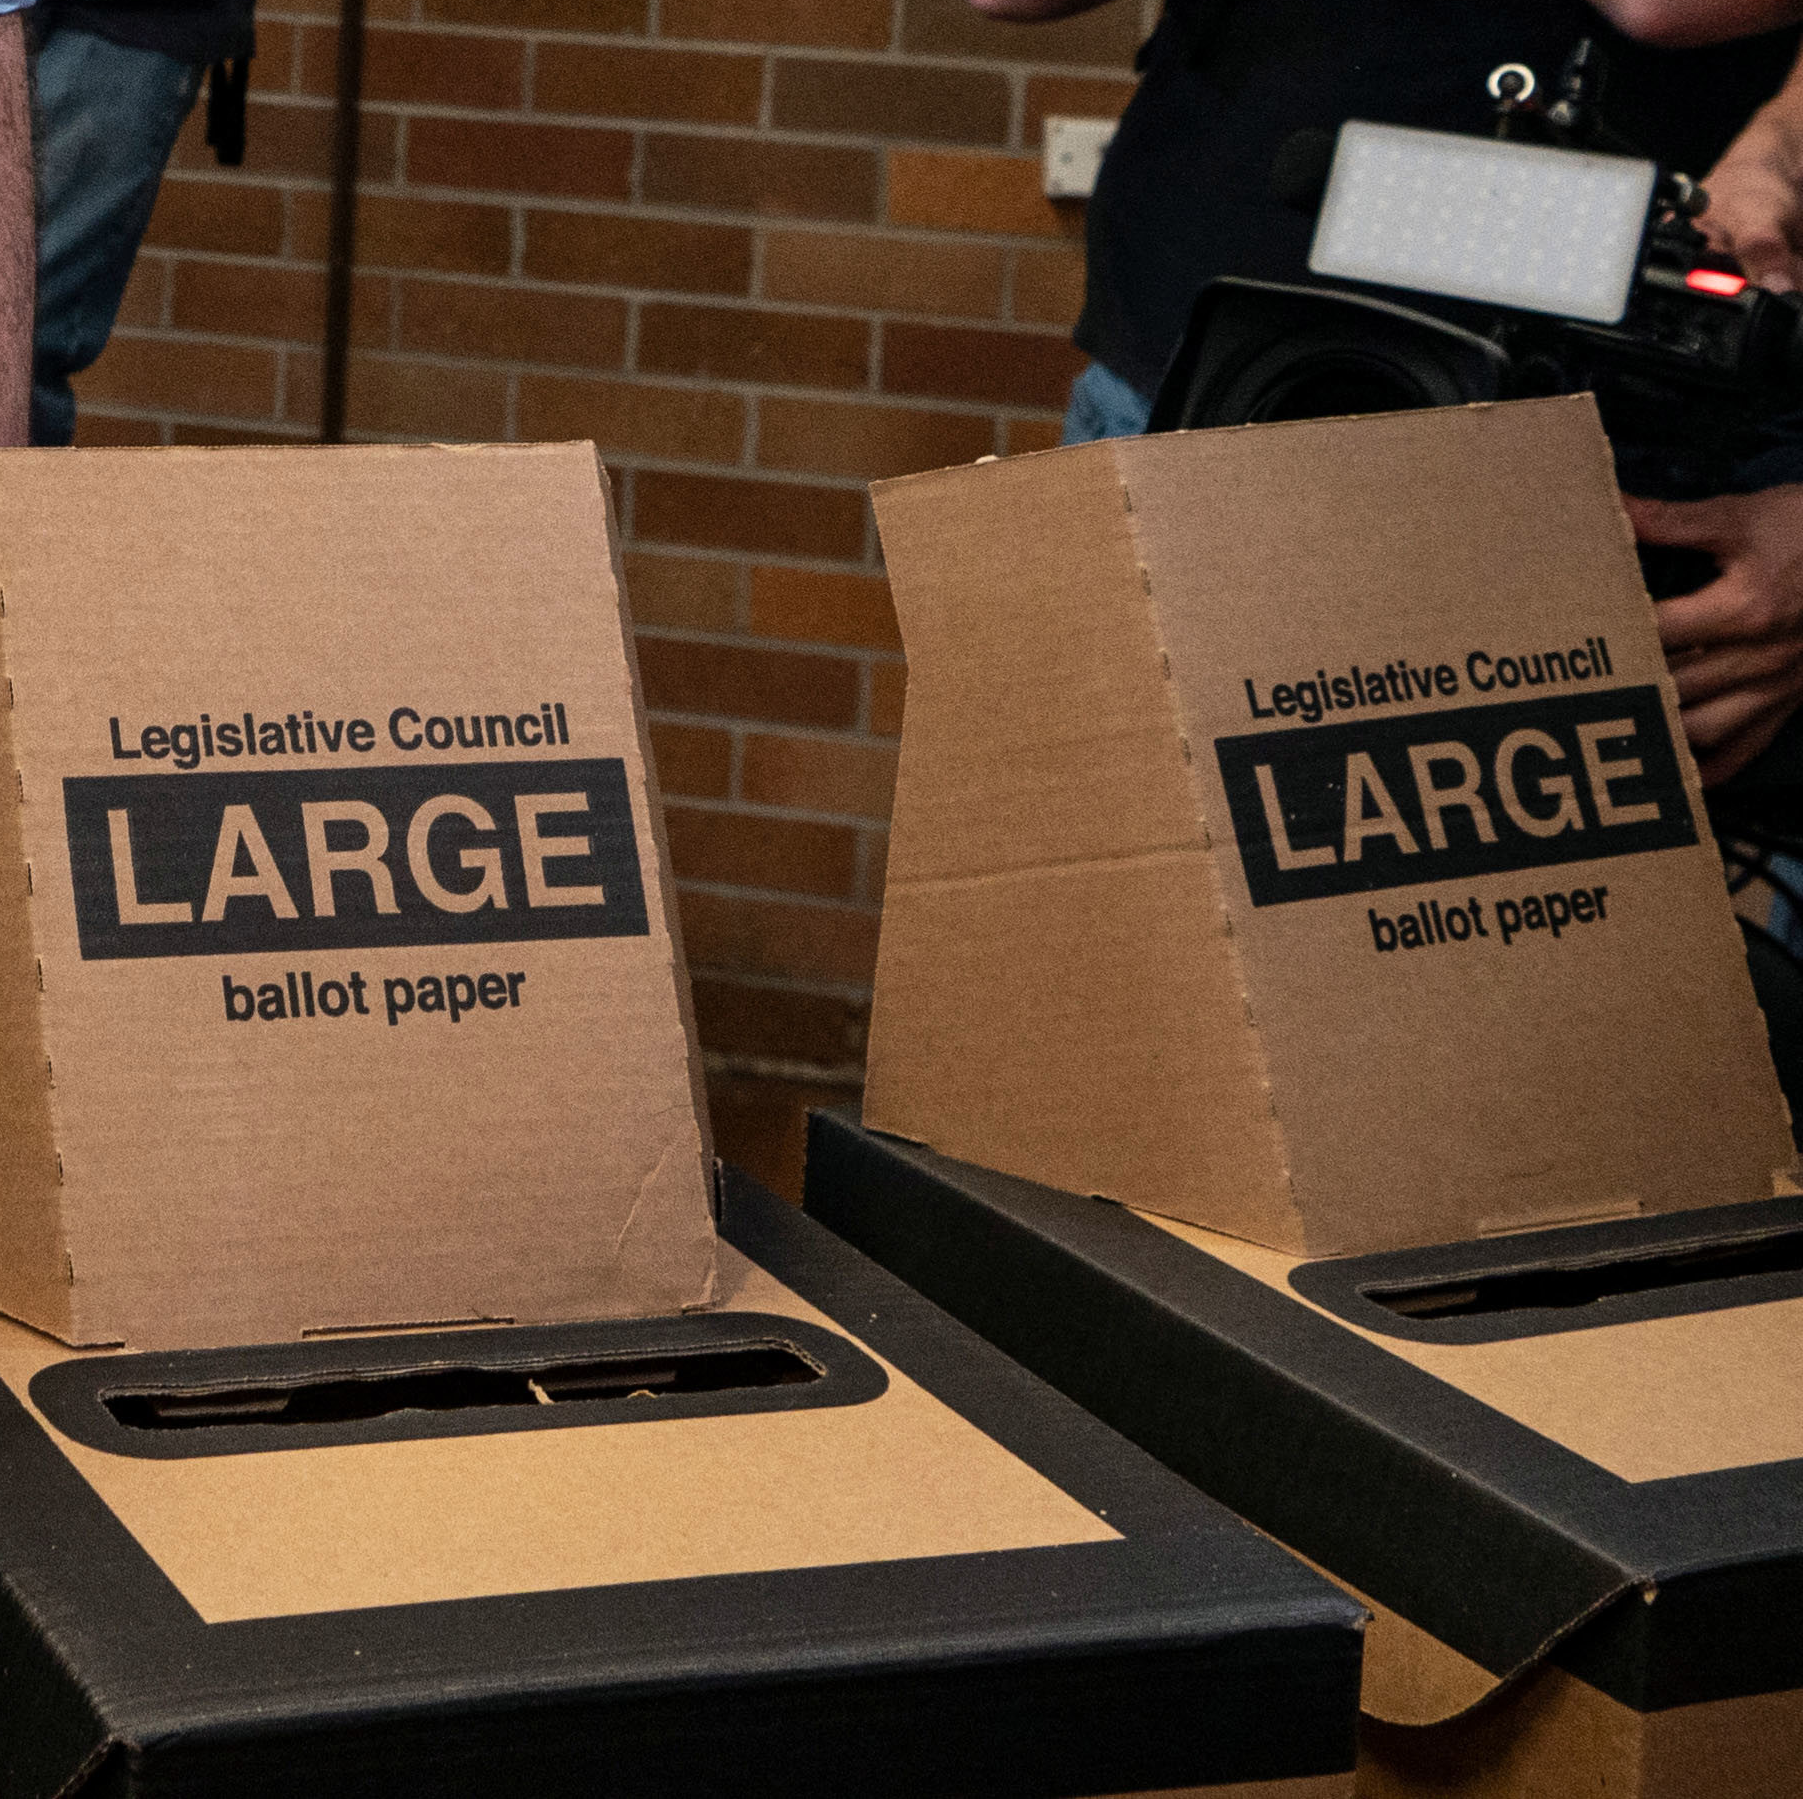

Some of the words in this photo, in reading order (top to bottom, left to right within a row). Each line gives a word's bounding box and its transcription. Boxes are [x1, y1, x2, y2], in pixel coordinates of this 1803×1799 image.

[1245, 660, 1459, 723] Legislative
[1466, 637, 1614, 692] Council
[108, 709, 377, 771] Legislative
[387, 701, 571, 753] Council
[1254, 717, 1662, 872] LARGE
[106, 791, 606, 926] LARGE
[1368, 896, 1489, 953] ballot
[1495, 886, 1610, 946] paper
[221, 970, 370, 1022] ballot
[382, 970, 527, 1027] paper
